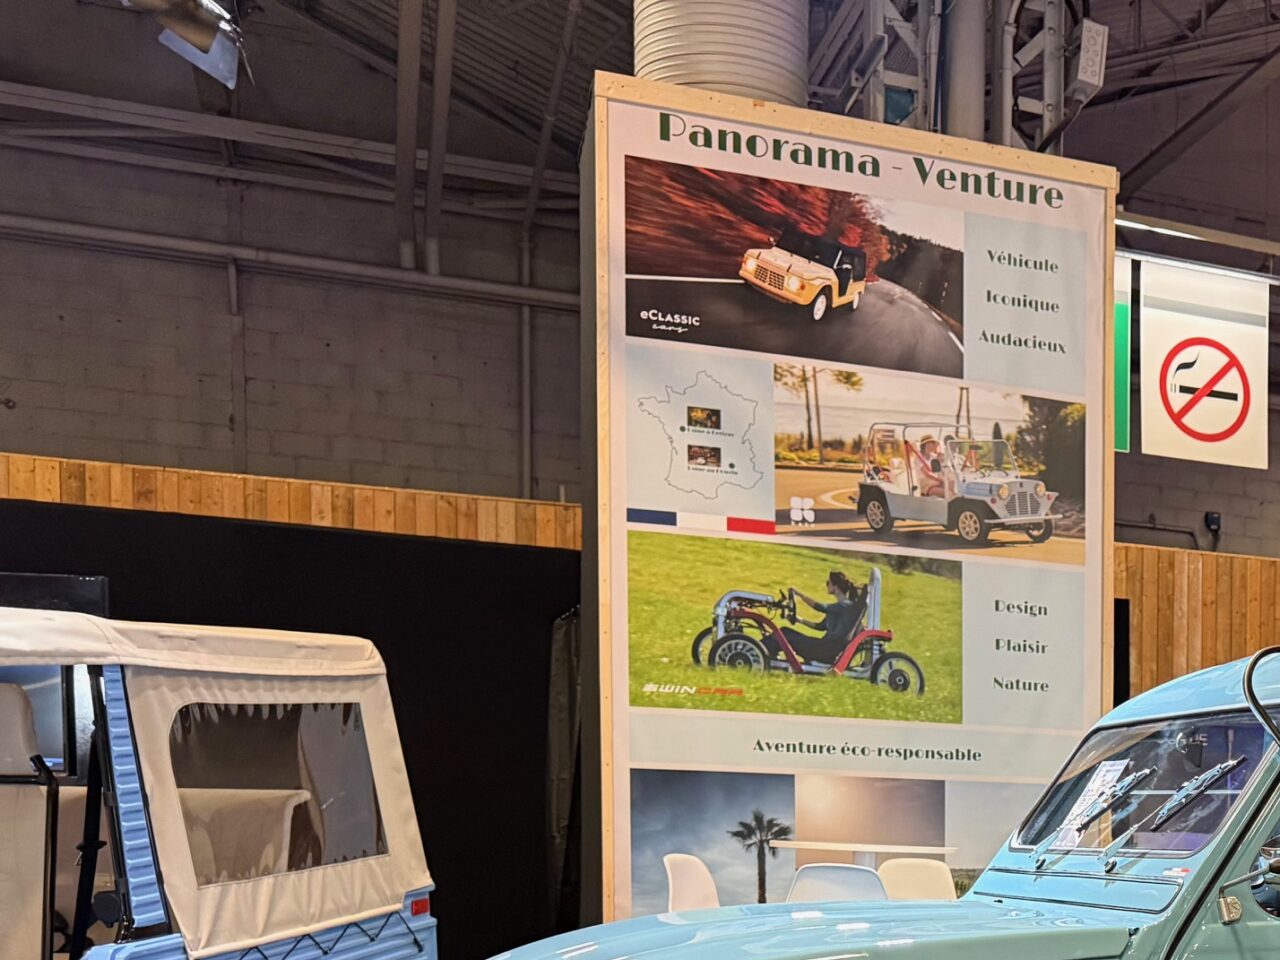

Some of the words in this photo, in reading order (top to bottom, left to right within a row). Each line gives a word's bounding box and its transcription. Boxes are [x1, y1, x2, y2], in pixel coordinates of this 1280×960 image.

[659, 112, 880, 178] Panorama
[912, 156, 1064, 209] Venture
[987, 249, 1059, 273] Véhicule
[986, 289, 1060, 313] Iconique
[979, 329, 1066, 354] Audacieux
[995, 599, 1048, 617] Design
[995, 638, 1049, 654] Plaisir
[993, 676, 1049, 692] Nature
[753, 738, 836, 755] Aventure
[841, 742, 982, 762] éco-responsable
